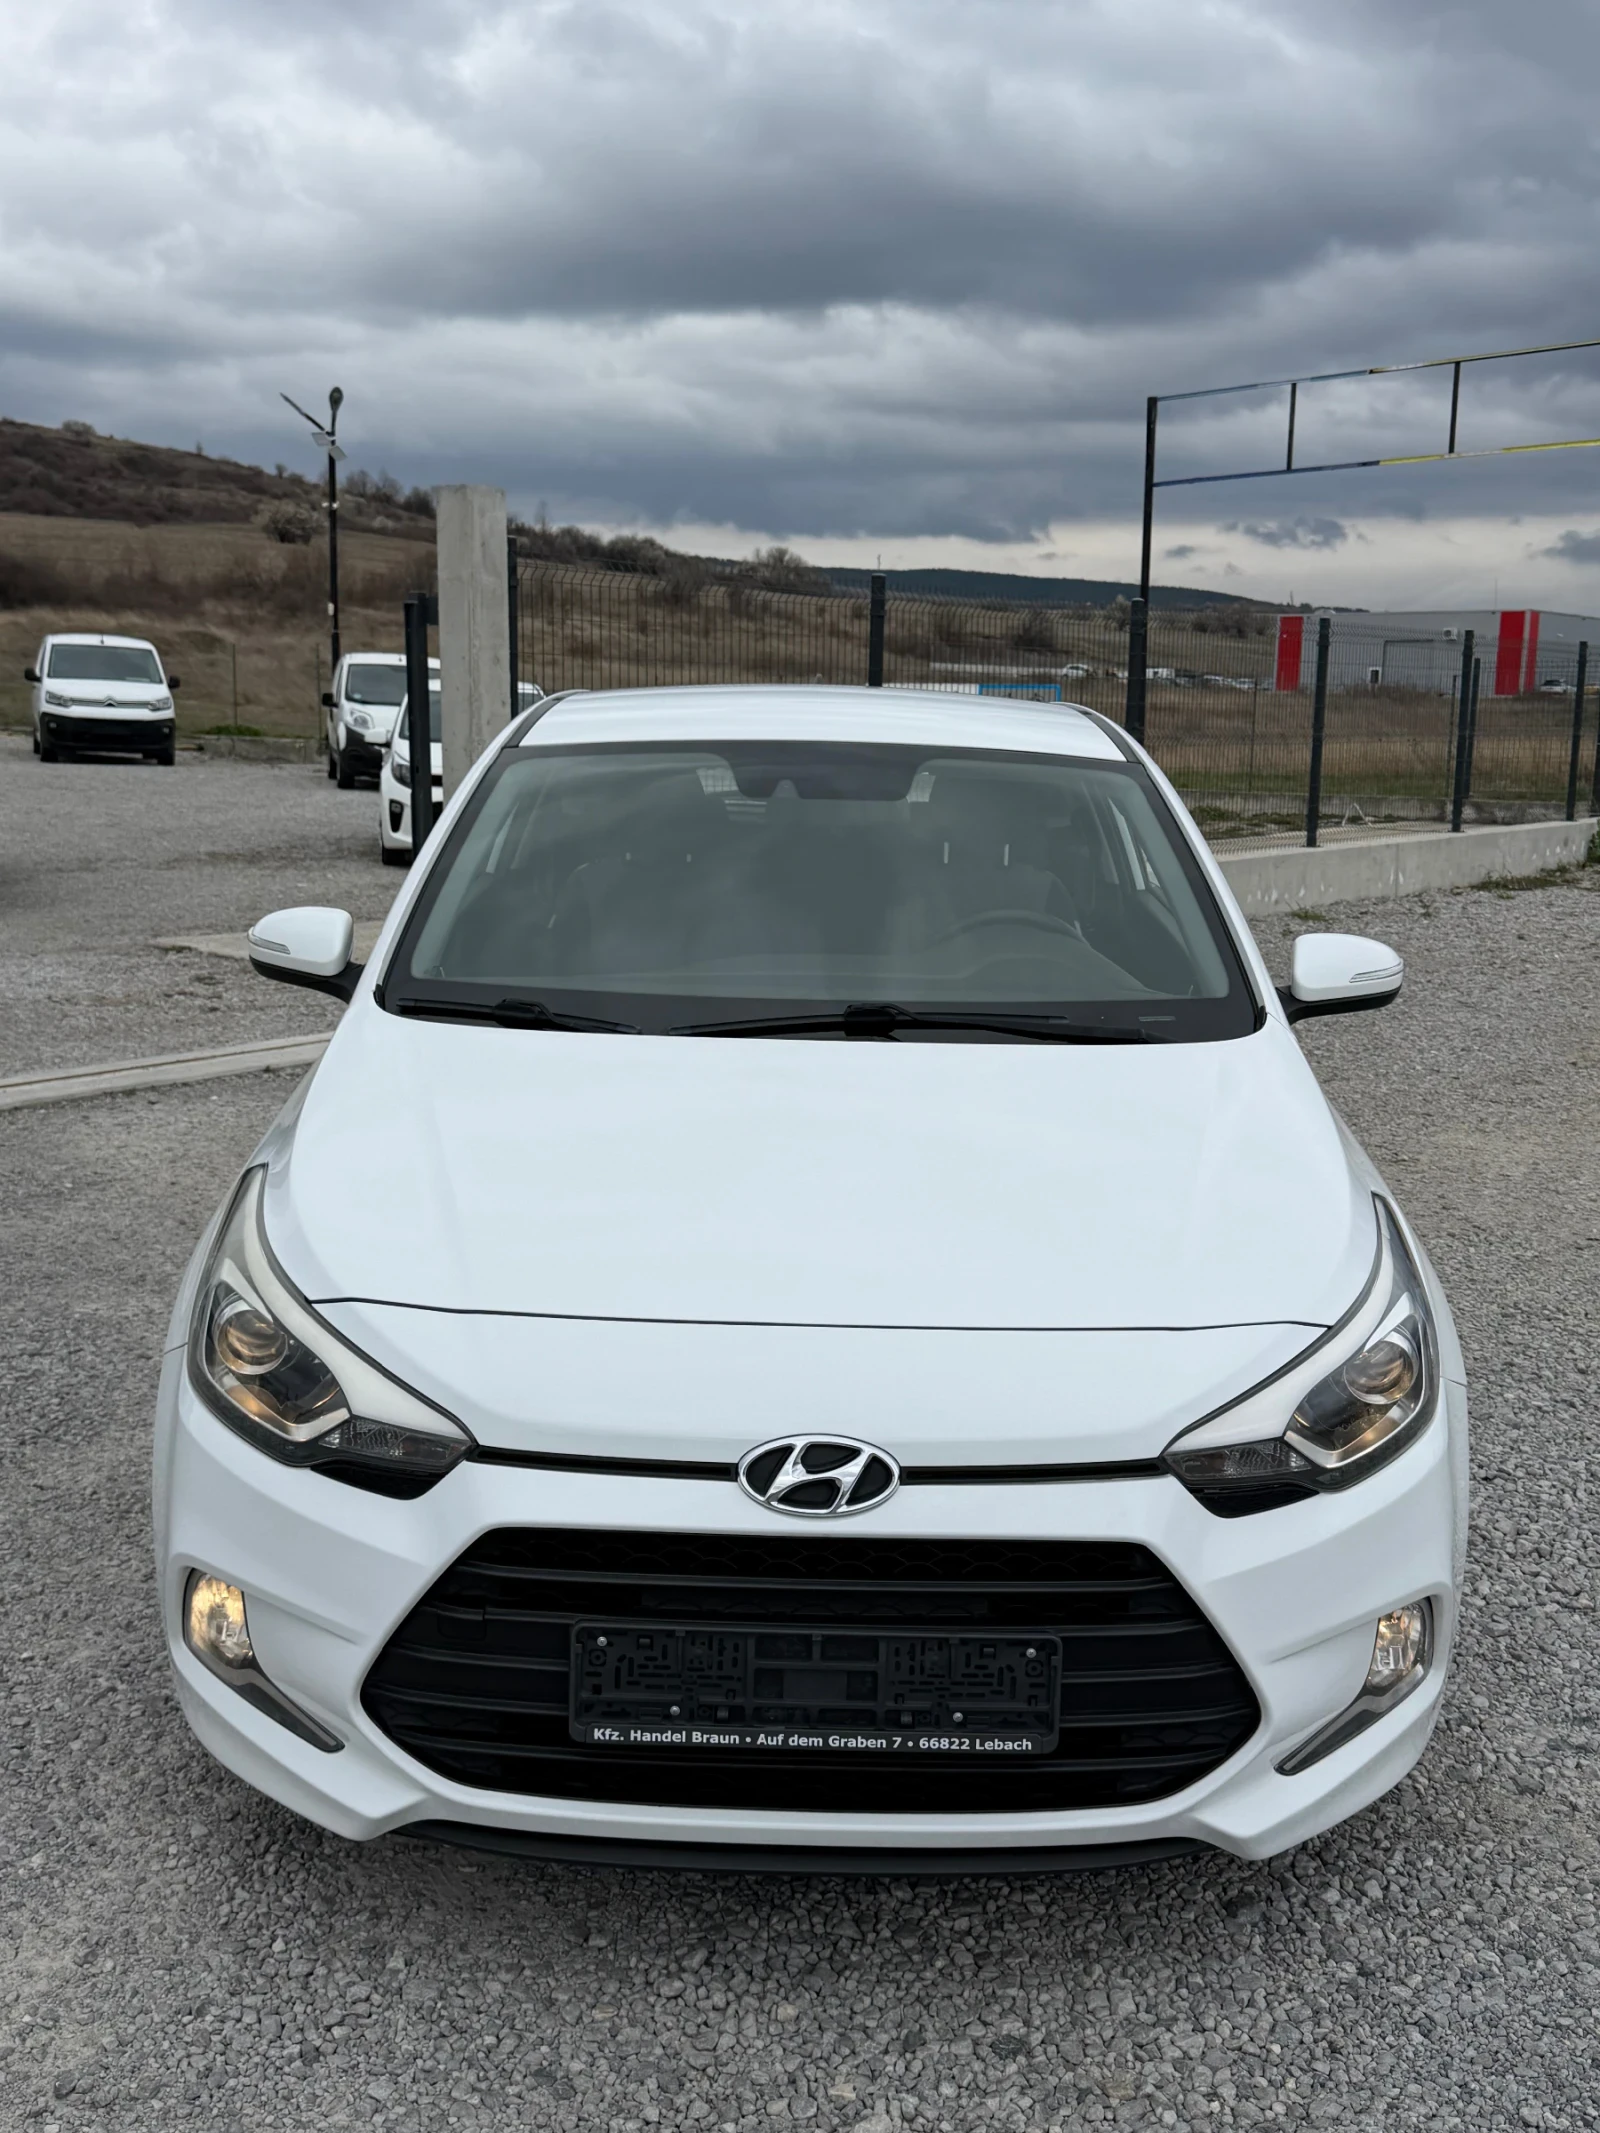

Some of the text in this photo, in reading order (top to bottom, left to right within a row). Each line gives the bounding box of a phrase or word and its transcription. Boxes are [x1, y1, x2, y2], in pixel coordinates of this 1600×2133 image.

[593, 1727, 1032, 1751] Kfz. Handel Braun Auf dem Graben 7 66822 Lebach
